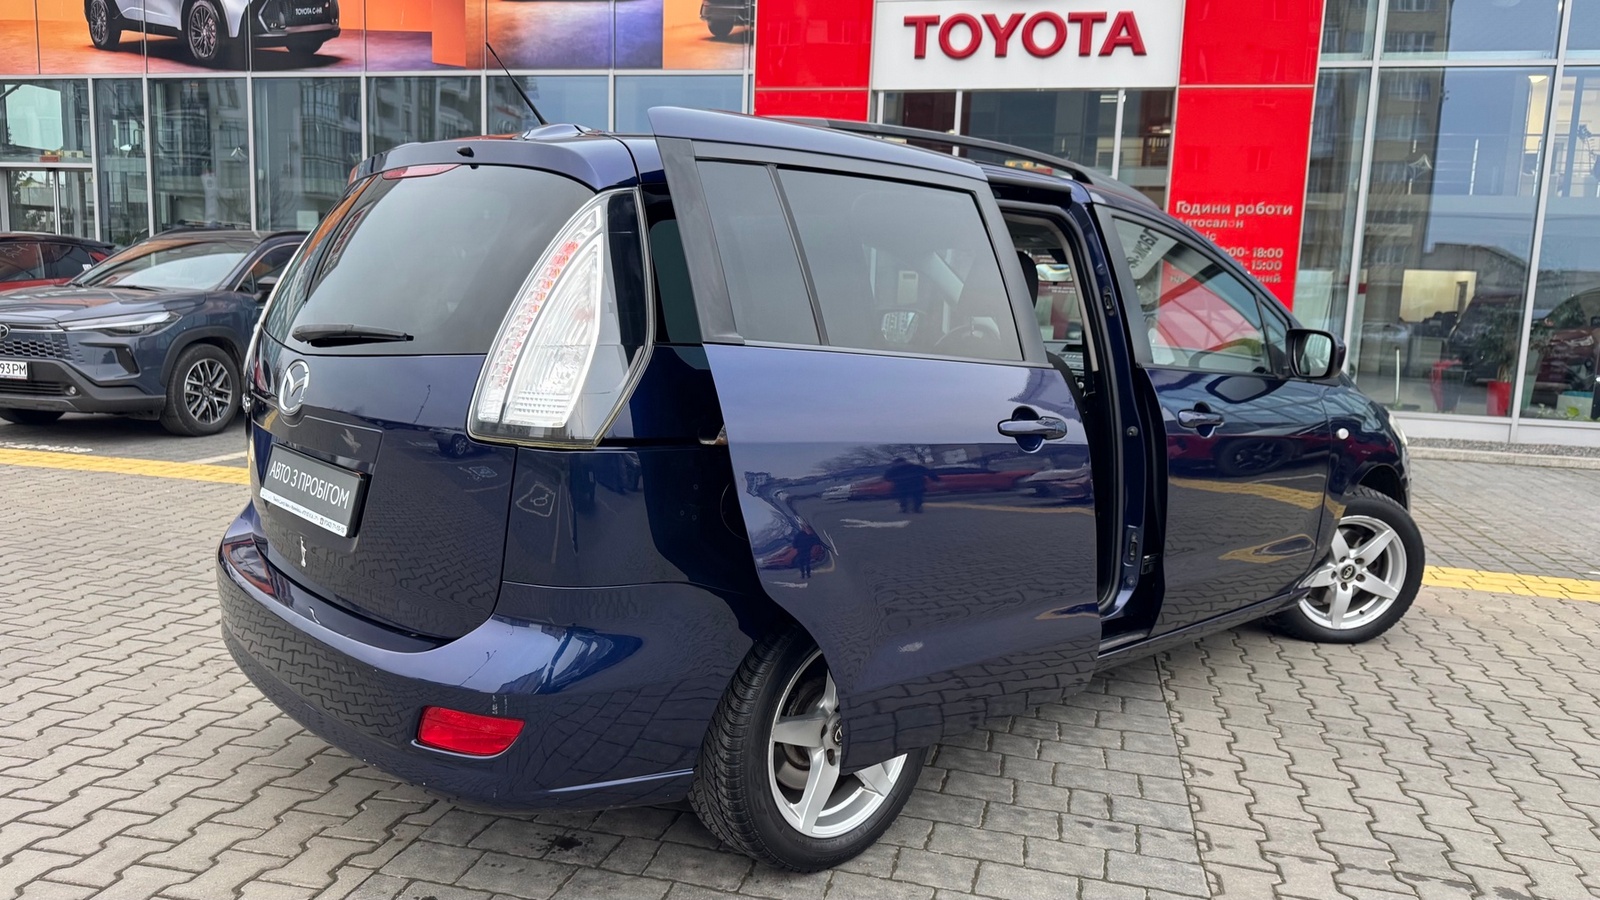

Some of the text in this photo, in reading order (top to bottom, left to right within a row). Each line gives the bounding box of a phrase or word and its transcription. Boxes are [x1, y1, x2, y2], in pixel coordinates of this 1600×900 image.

[904, 11, 1147, 60] TOYOTA
[1176, 201, 1293, 217] Години роботи
[1252, 247, 1284, 259] 18:00
[269, 461, 291, 483] АВТО
[298, 472, 350, 509] ПРОБІГОМ
